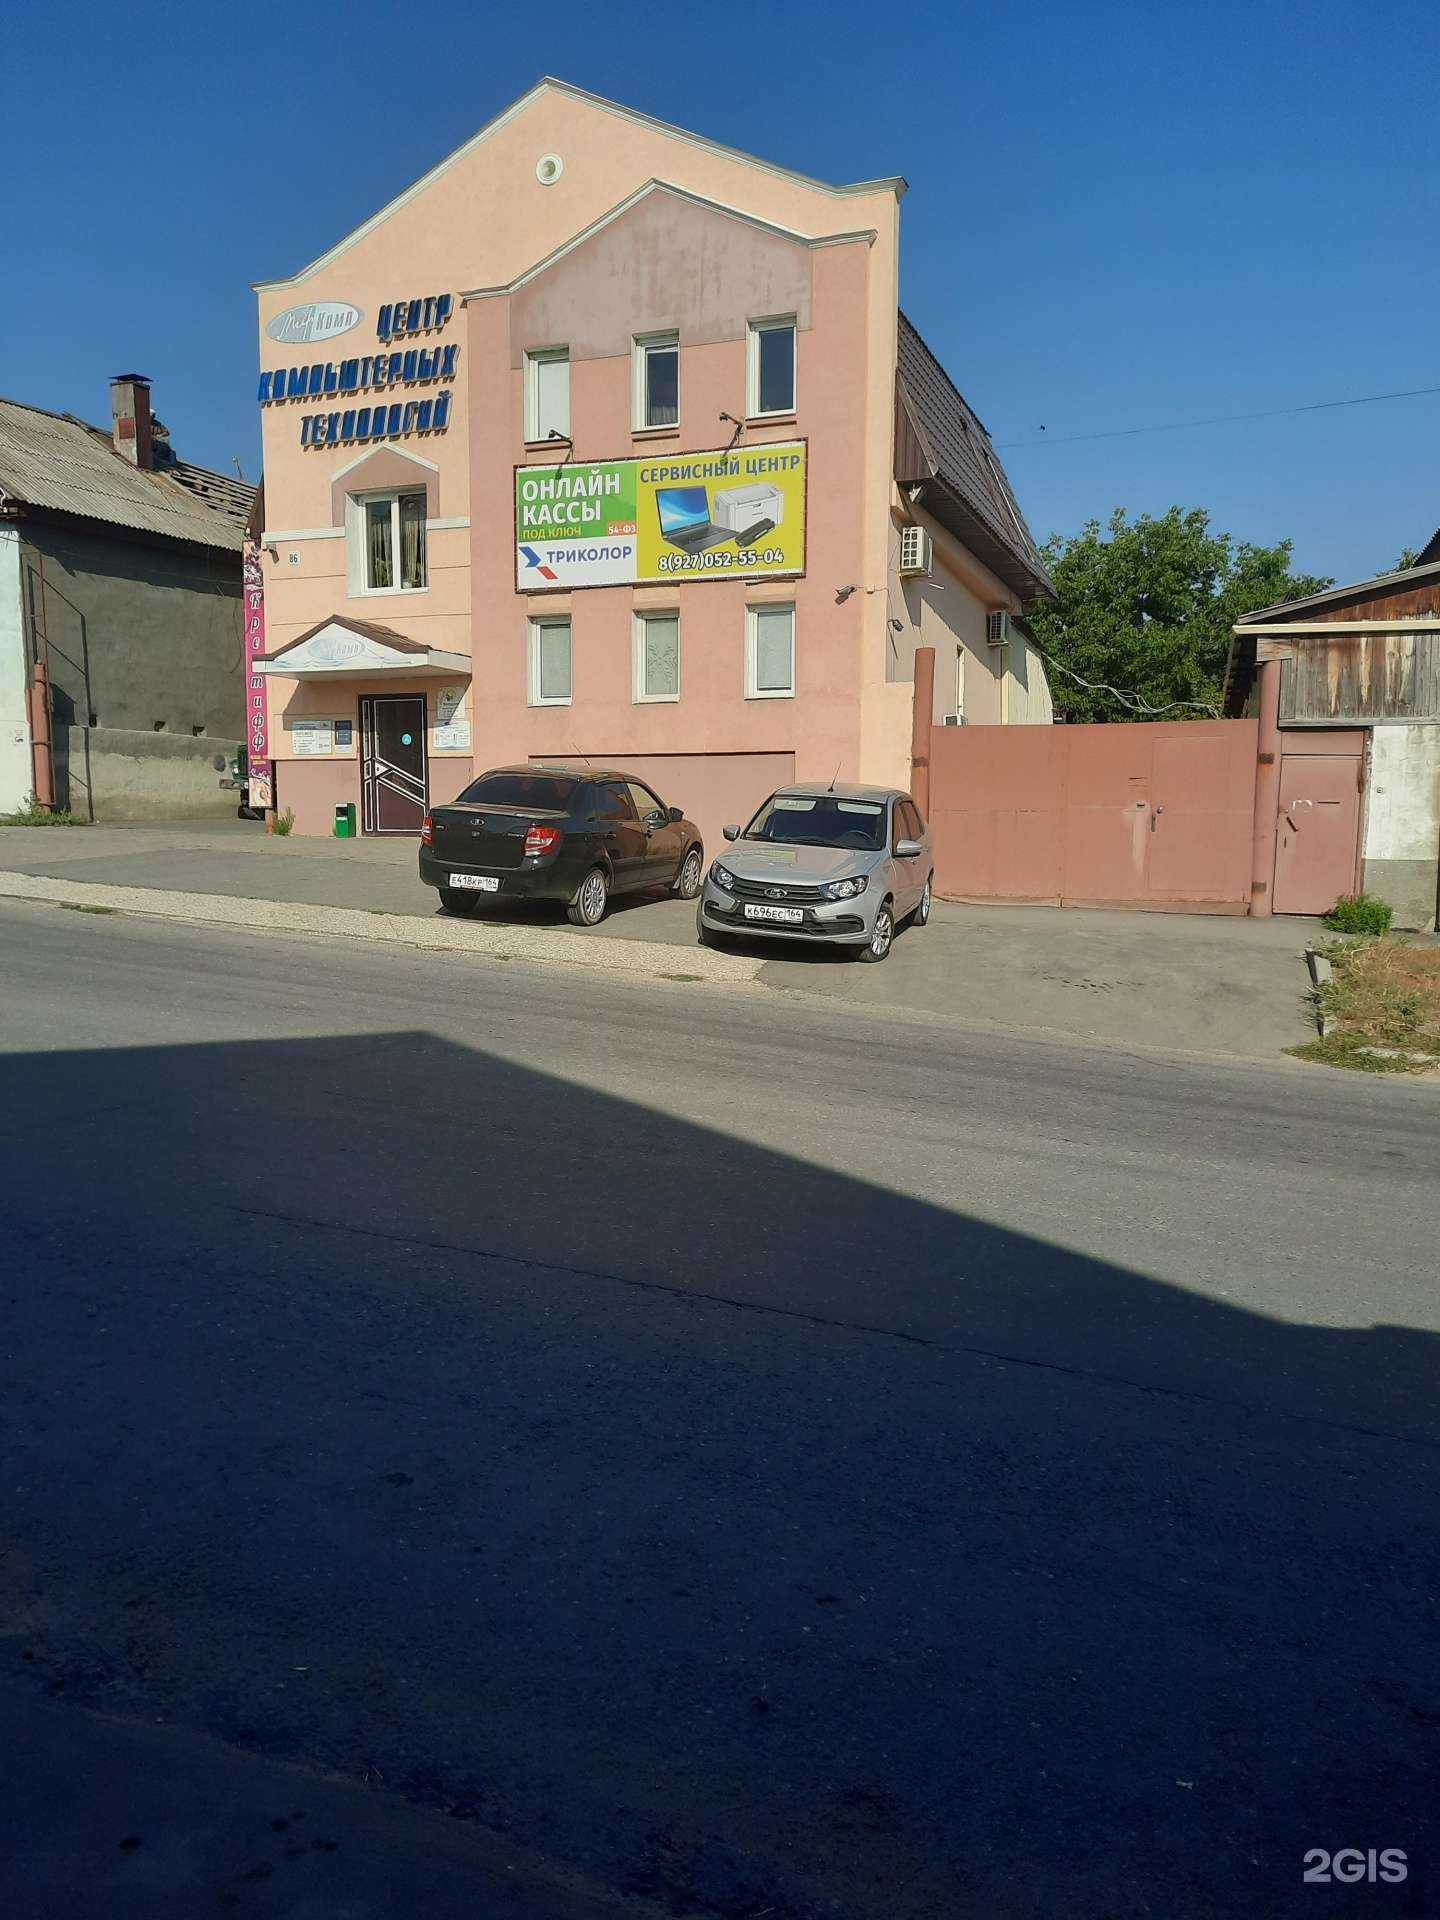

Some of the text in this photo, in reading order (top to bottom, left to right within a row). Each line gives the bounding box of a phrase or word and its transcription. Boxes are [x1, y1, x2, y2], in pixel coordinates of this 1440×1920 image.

[376, 293, 454, 345] ЦЕНТР
[258, 344, 461, 405] КОМПЬЮТЕРНЫХ
[300, 390, 453, 448] ТЕХНОЛОГИЙ
[522, 468, 621, 501] ОНЛАЙН
[640, 454, 801, 484] СЕРВИСНЫЙ ЦЕНТР
[522, 501, 601, 526] КАССЫ
[522, 526, 581, 540] ПОД КЛЮЧ
[547, 546, 632, 564] ТРИКОЛОР
[658, 549, 785, 574] 8(927)052-55-04
[249, 592, 265, 752] Кретифф
